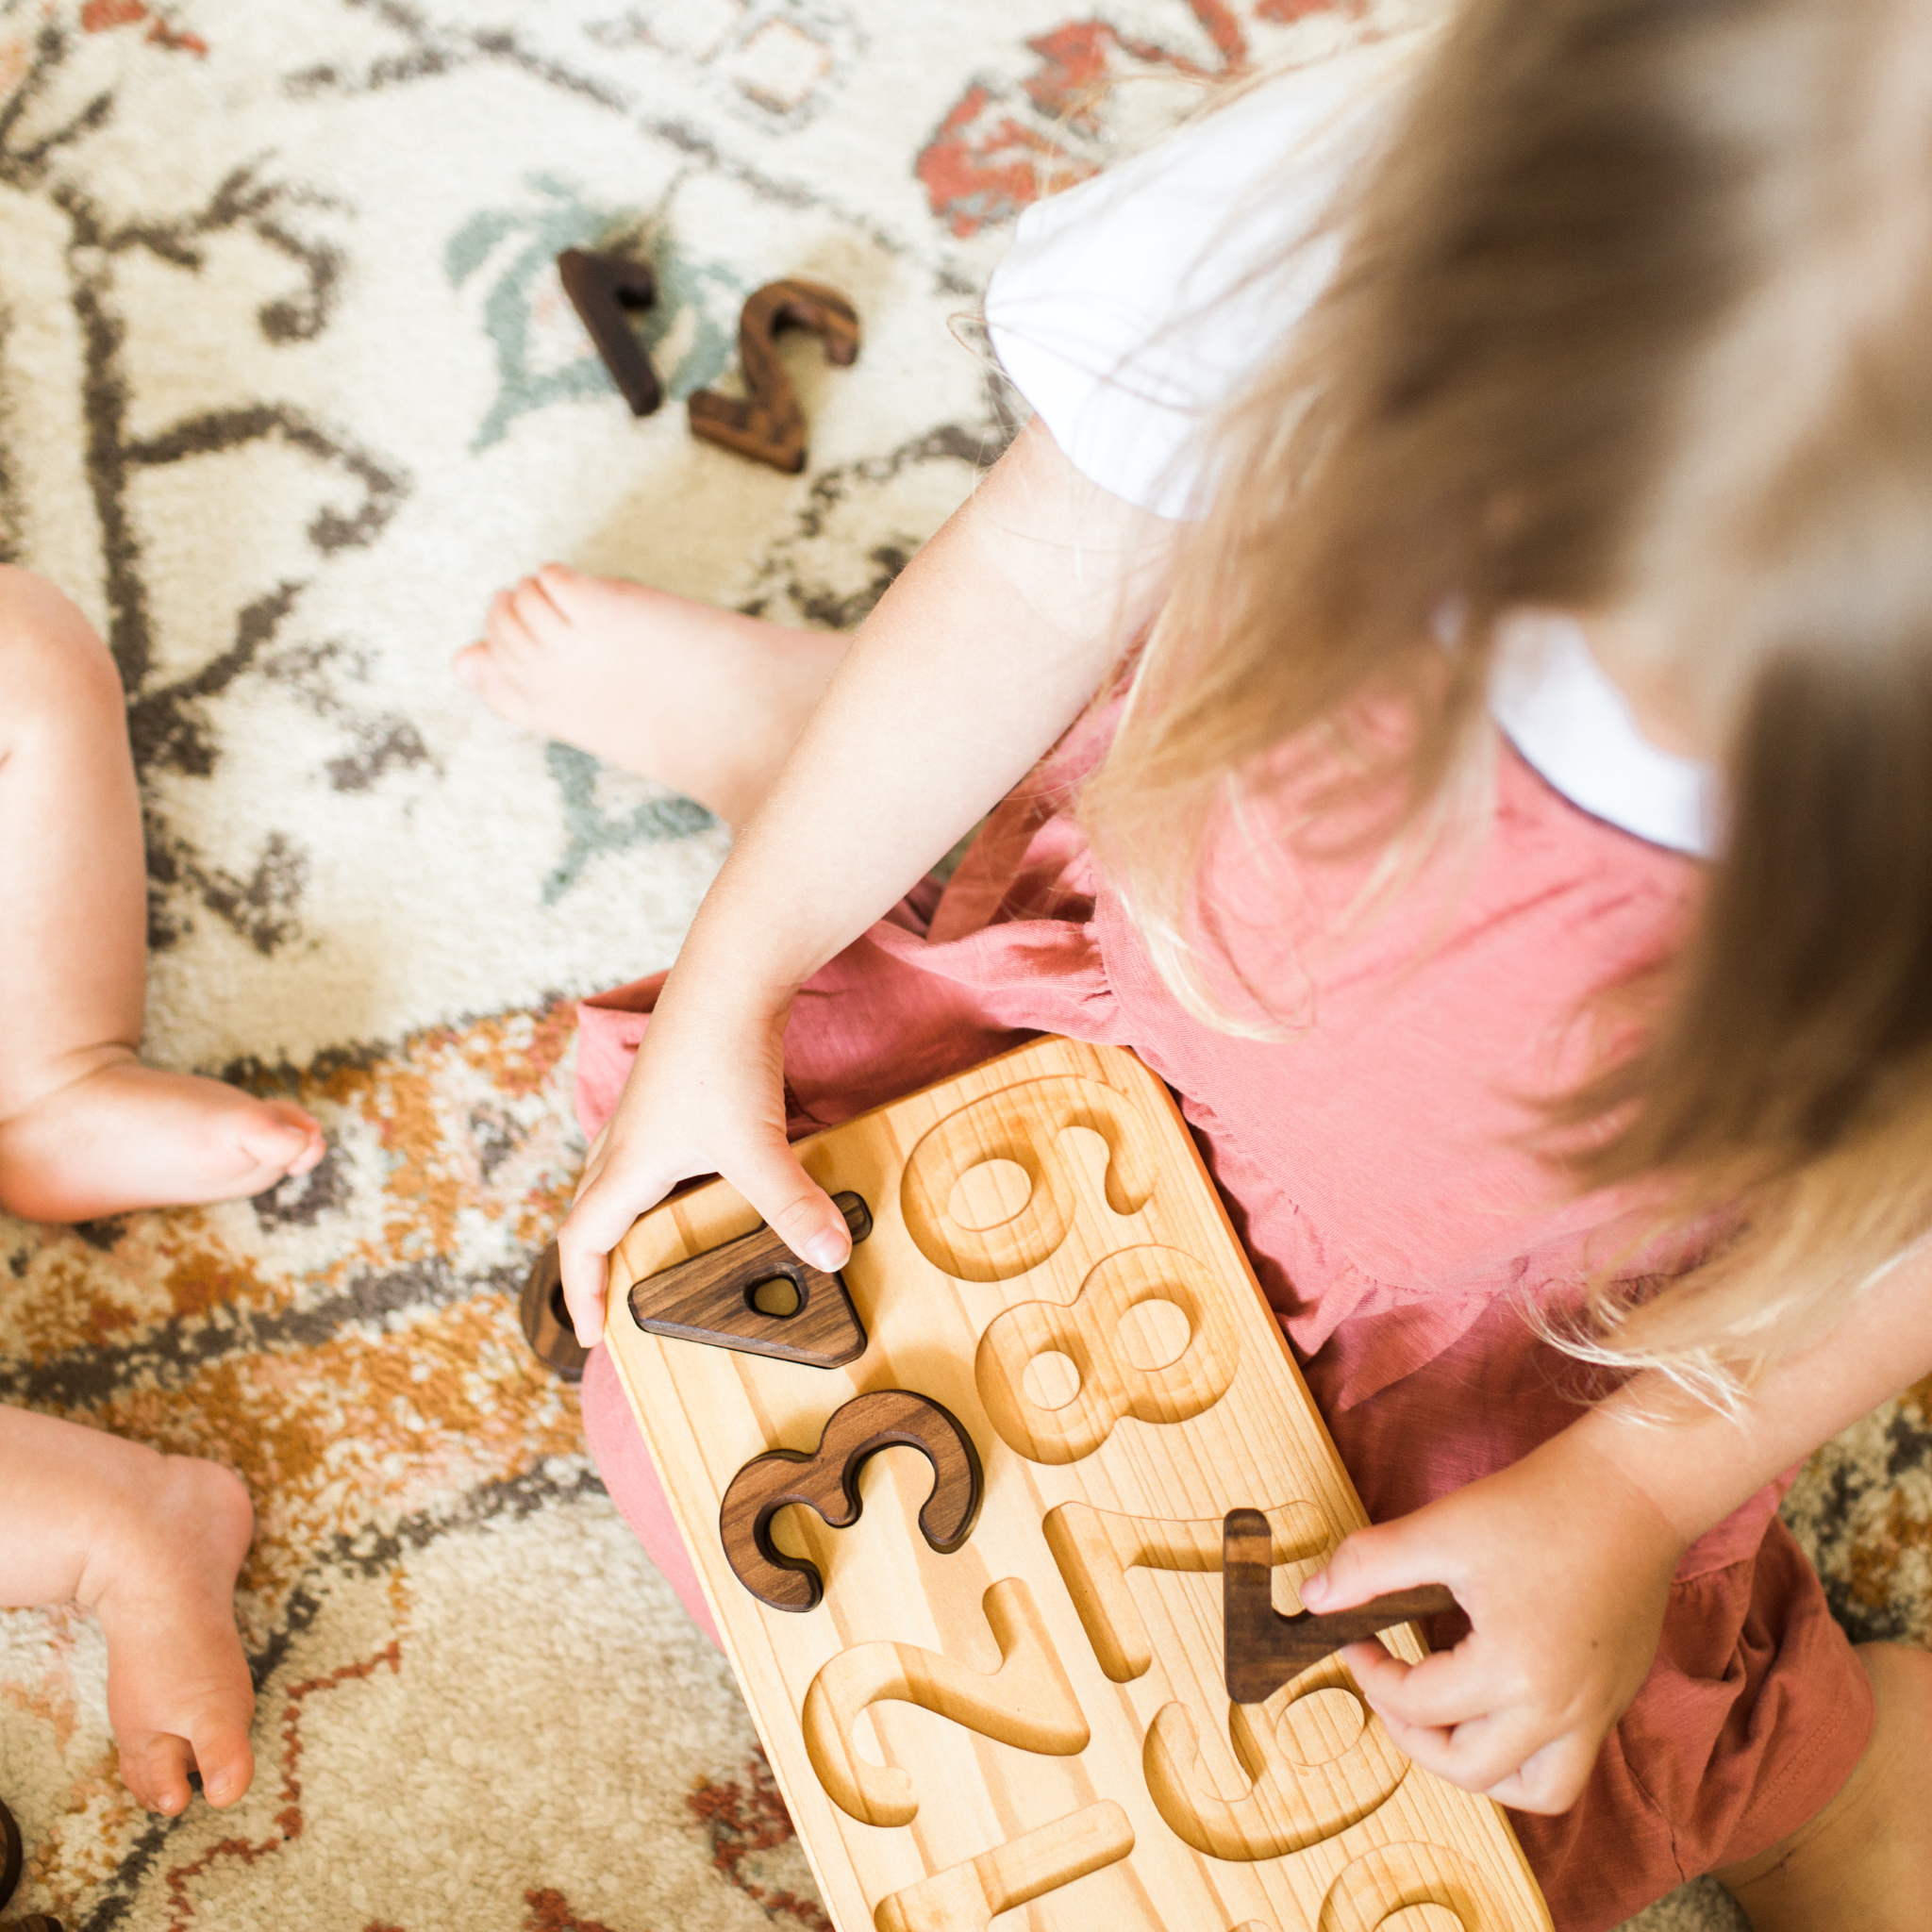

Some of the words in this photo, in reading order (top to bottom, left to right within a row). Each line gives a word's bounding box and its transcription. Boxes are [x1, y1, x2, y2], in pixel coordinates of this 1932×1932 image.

[628, 1191, 873, 1370] 4
[974, 1243, 1241, 1465] 8
[720, 1389, 984, 1612] 3
[1042, 1500, 1330, 1683] 7
[802, 1576, 1091, 1827] 2
